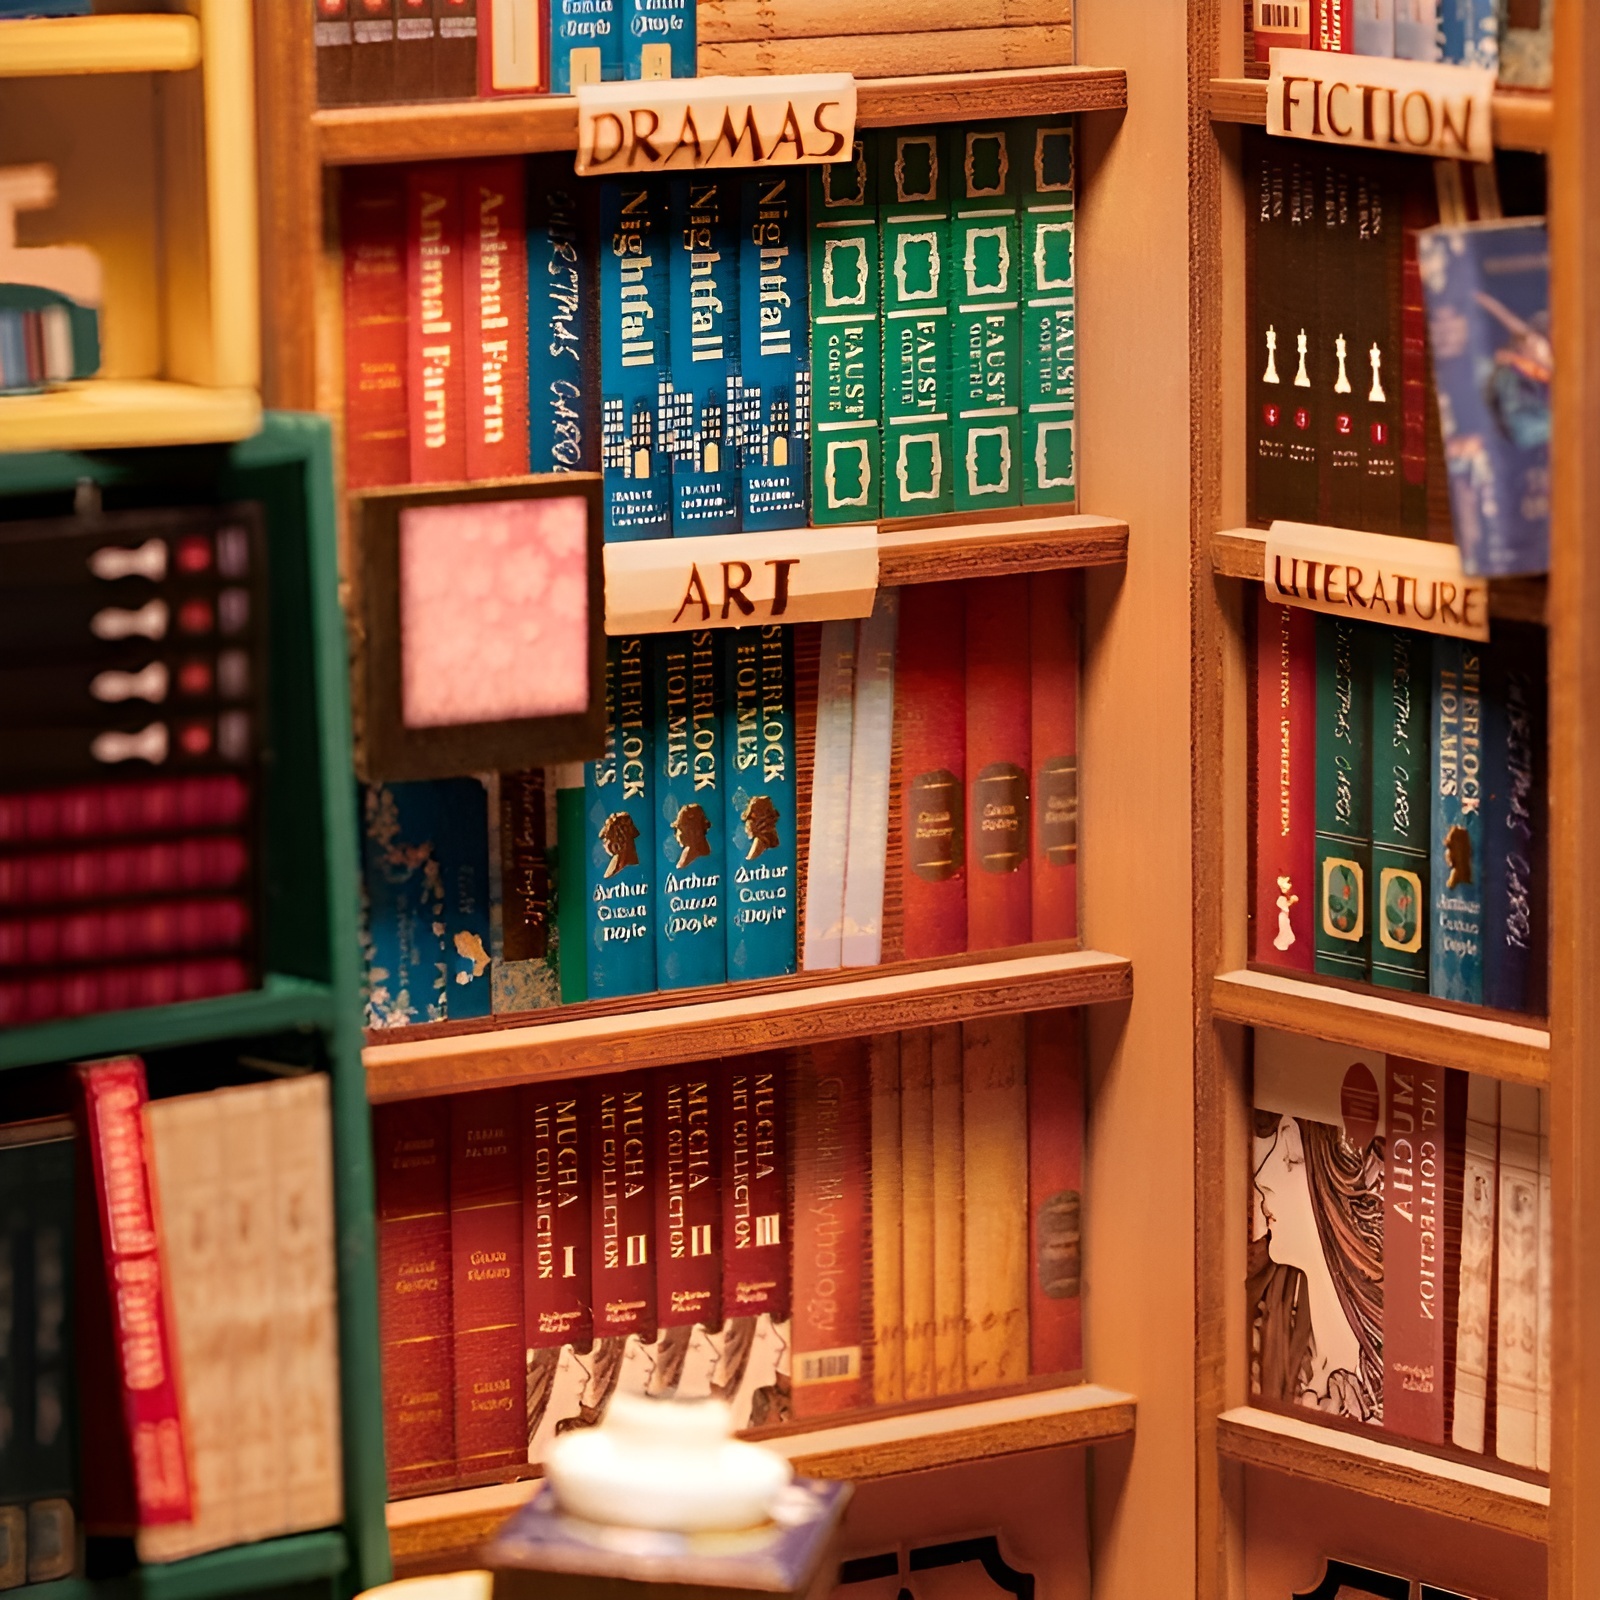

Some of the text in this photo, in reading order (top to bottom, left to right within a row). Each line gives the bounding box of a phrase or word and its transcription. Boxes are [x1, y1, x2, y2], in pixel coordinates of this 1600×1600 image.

[590, 101, 845, 168] DRAMAS
[1282, 75, 1475, 153] FICTION
[420, 191, 451, 449] Animal Farm
[480, 188, 508, 443] Animal Farm
[612, 191, 654, 367] Nightfall
[683, 184, 723, 362] Nightfall
[752, 179, 791, 355] Nightfall
[844, 326, 865, 418] FAUST
[917, 320, 937, 412] FAUST
[985, 315, 1006, 406] FAUST
[1055, 309, 1075, 401] FAUST
[672, 559, 800, 623] ART
[1274, 555, 1484, 627] LITERATURE
[621, 639, 645, 800] SHERLOCK
[667, 654, 688, 777] HOLMES
[692, 631, 715, 791] SHERLOCK
[736, 646, 758, 770] HOLMES
[762, 625, 785, 783] SHERLOCK
[1439, 670, 1458, 797] HOLMES
[1460, 655, 1481, 815] SHERLOCK
[556, 1099, 578, 1208] MUCHA
[623, 1091, 645, 1199] MUCHA
[688, 1082, 709, 1192] MUCHA
[755, 1073, 775, 1179] MUCHA
[808, 1178, 845, 1331] Mythology
